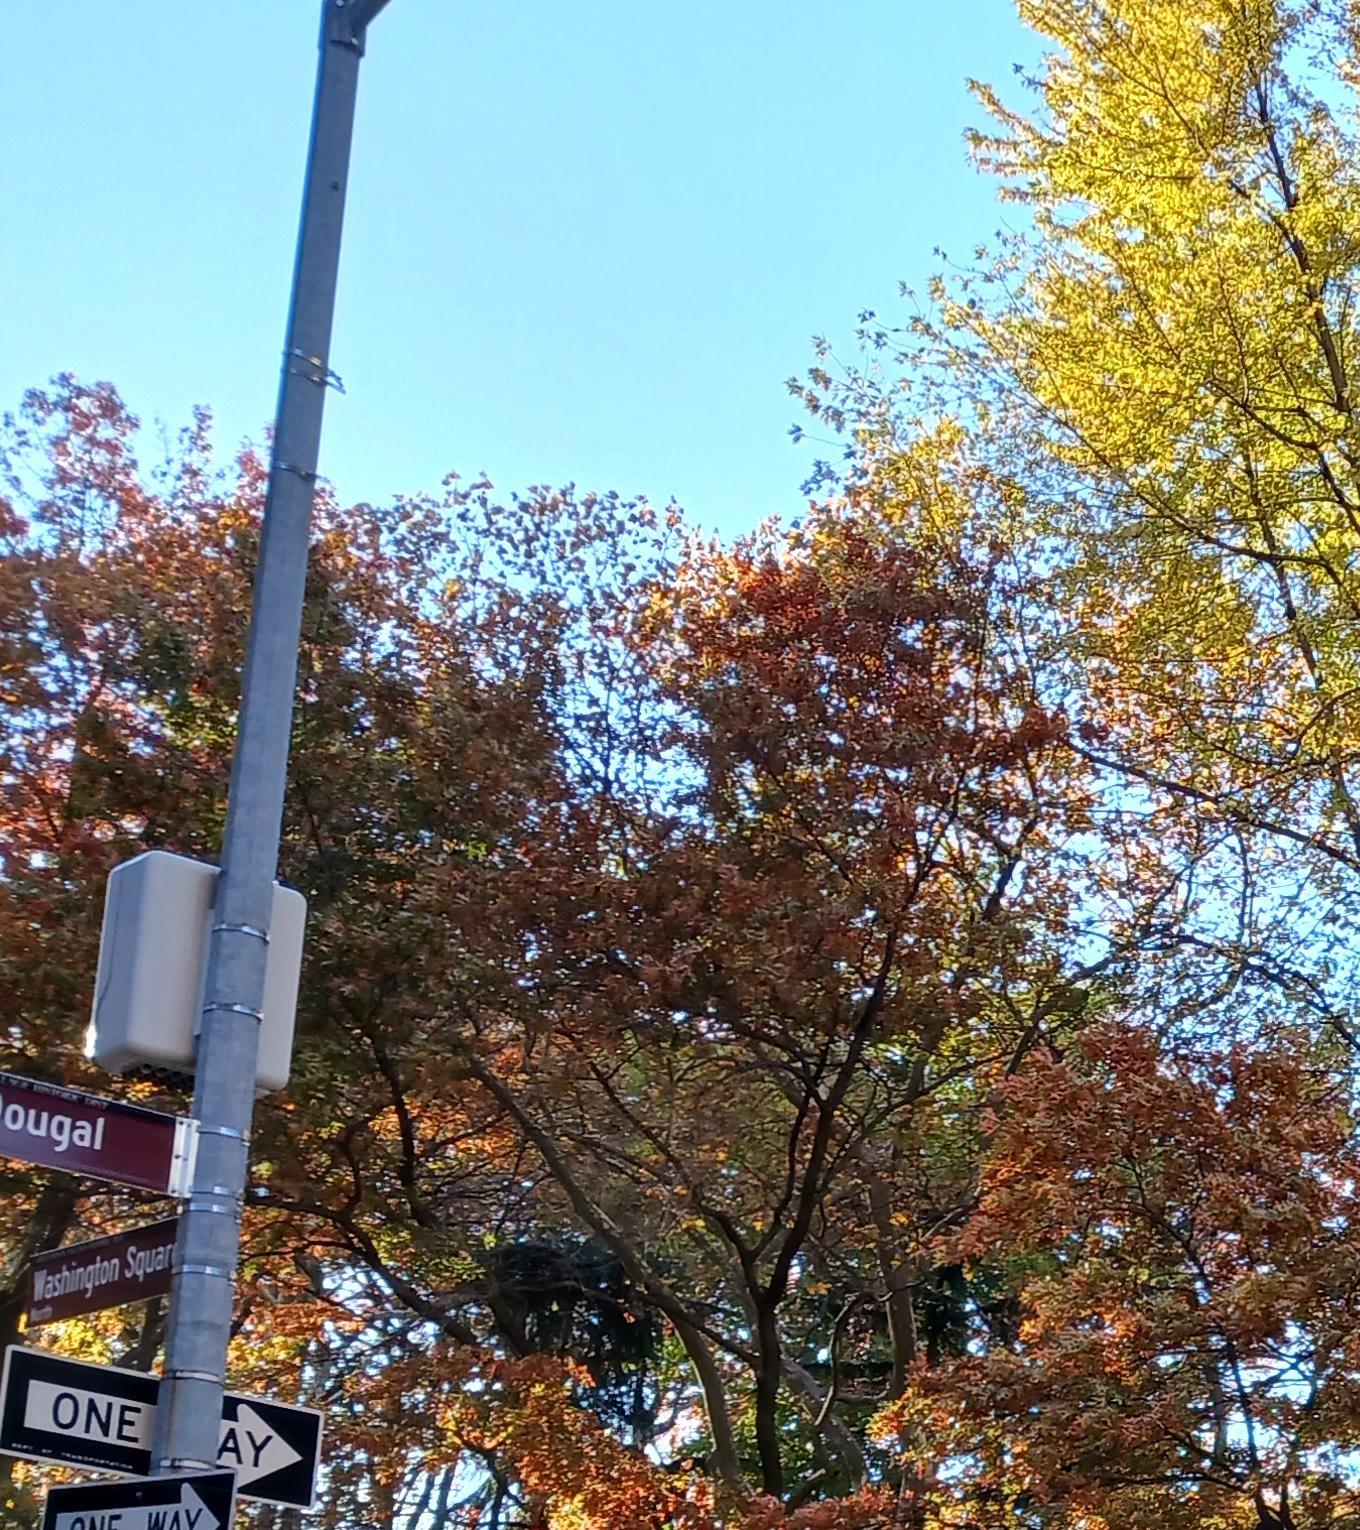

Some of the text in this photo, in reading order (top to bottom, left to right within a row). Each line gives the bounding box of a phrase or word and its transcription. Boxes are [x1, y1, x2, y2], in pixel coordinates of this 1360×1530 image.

[0, 1093, 105, 1152] ougal
[34, 1256, 120, 1301] Washington
[52, 1392, 273, 1468] ONE AY
